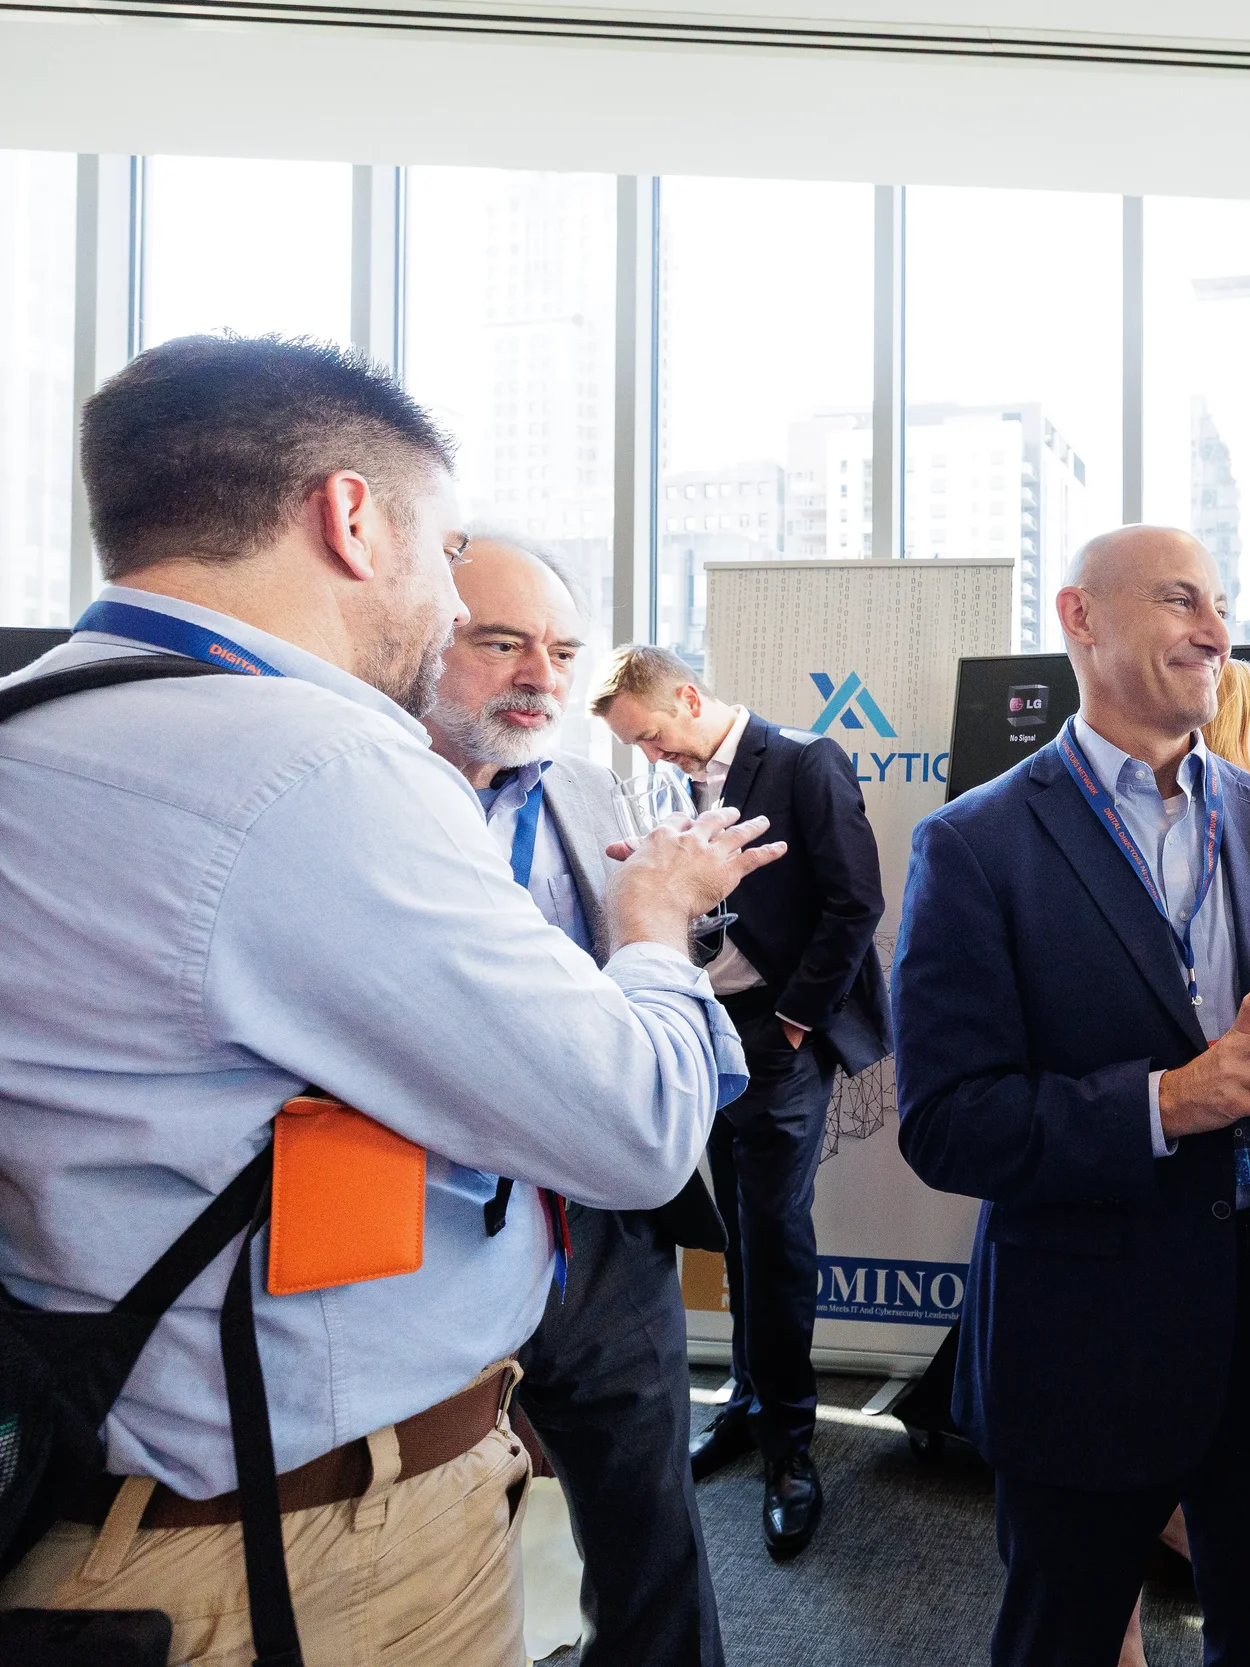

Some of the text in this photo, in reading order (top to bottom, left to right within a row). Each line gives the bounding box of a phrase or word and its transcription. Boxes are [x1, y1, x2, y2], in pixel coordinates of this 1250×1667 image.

[1026, 699, 1042, 709] LG
[1010, 734, 1036, 743] No Signal
[1076, 766, 1099, 796] NETWORK
[1103, 807, 1121, 832] DIGITAL
[1118, 831, 1143, 865] DIRECTORS
[817, 1265, 964, 1310] MINO
[828, 1304, 850, 1313] Meets
[850, 1305, 859, 1313] IT
[859, 1306, 874, 1315] And
[874, 1307, 923, 1319] Cybersecurity
